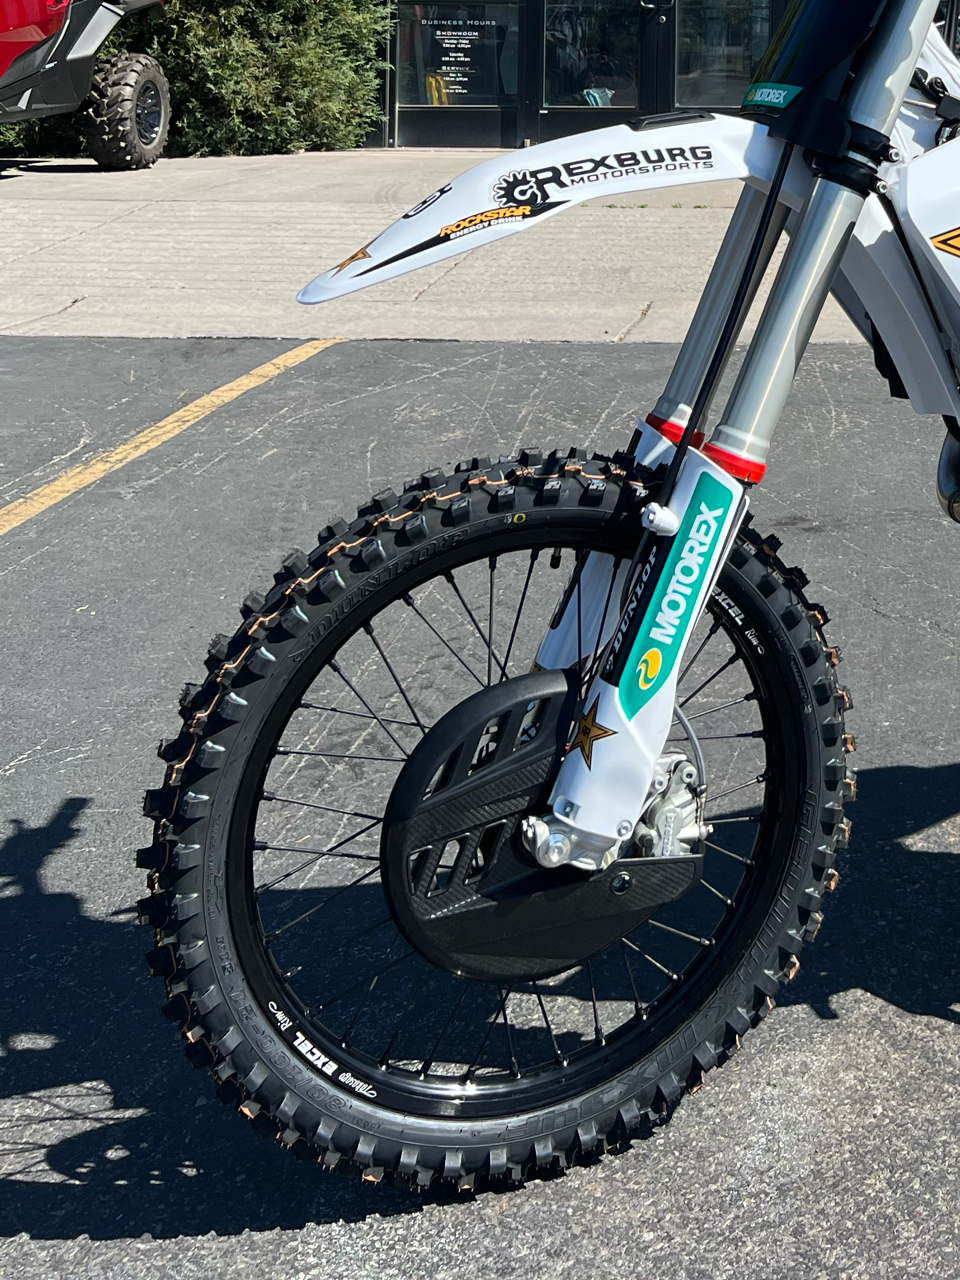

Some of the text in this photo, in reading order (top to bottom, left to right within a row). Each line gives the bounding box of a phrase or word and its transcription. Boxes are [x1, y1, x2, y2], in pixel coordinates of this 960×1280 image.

[753, 88, 788, 104] MOTOREX
[528, 146, 713, 202] REXBURG
[570, 160, 714, 186] MOTORSPORTS
[439, 205, 531, 238] ROCKSTAR
[449, 215, 524, 239] ENERGY DRINK
[308, 529, 469, 646] DUNLOP
[649, 502, 725, 646] MOTOREX
[612, 545, 659, 650] DUNLOP
[744, 627, 766, 655] Rim
[268, 1001, 293, 1032] Rim
[293, 1031, 339, 1076] EXCEL
